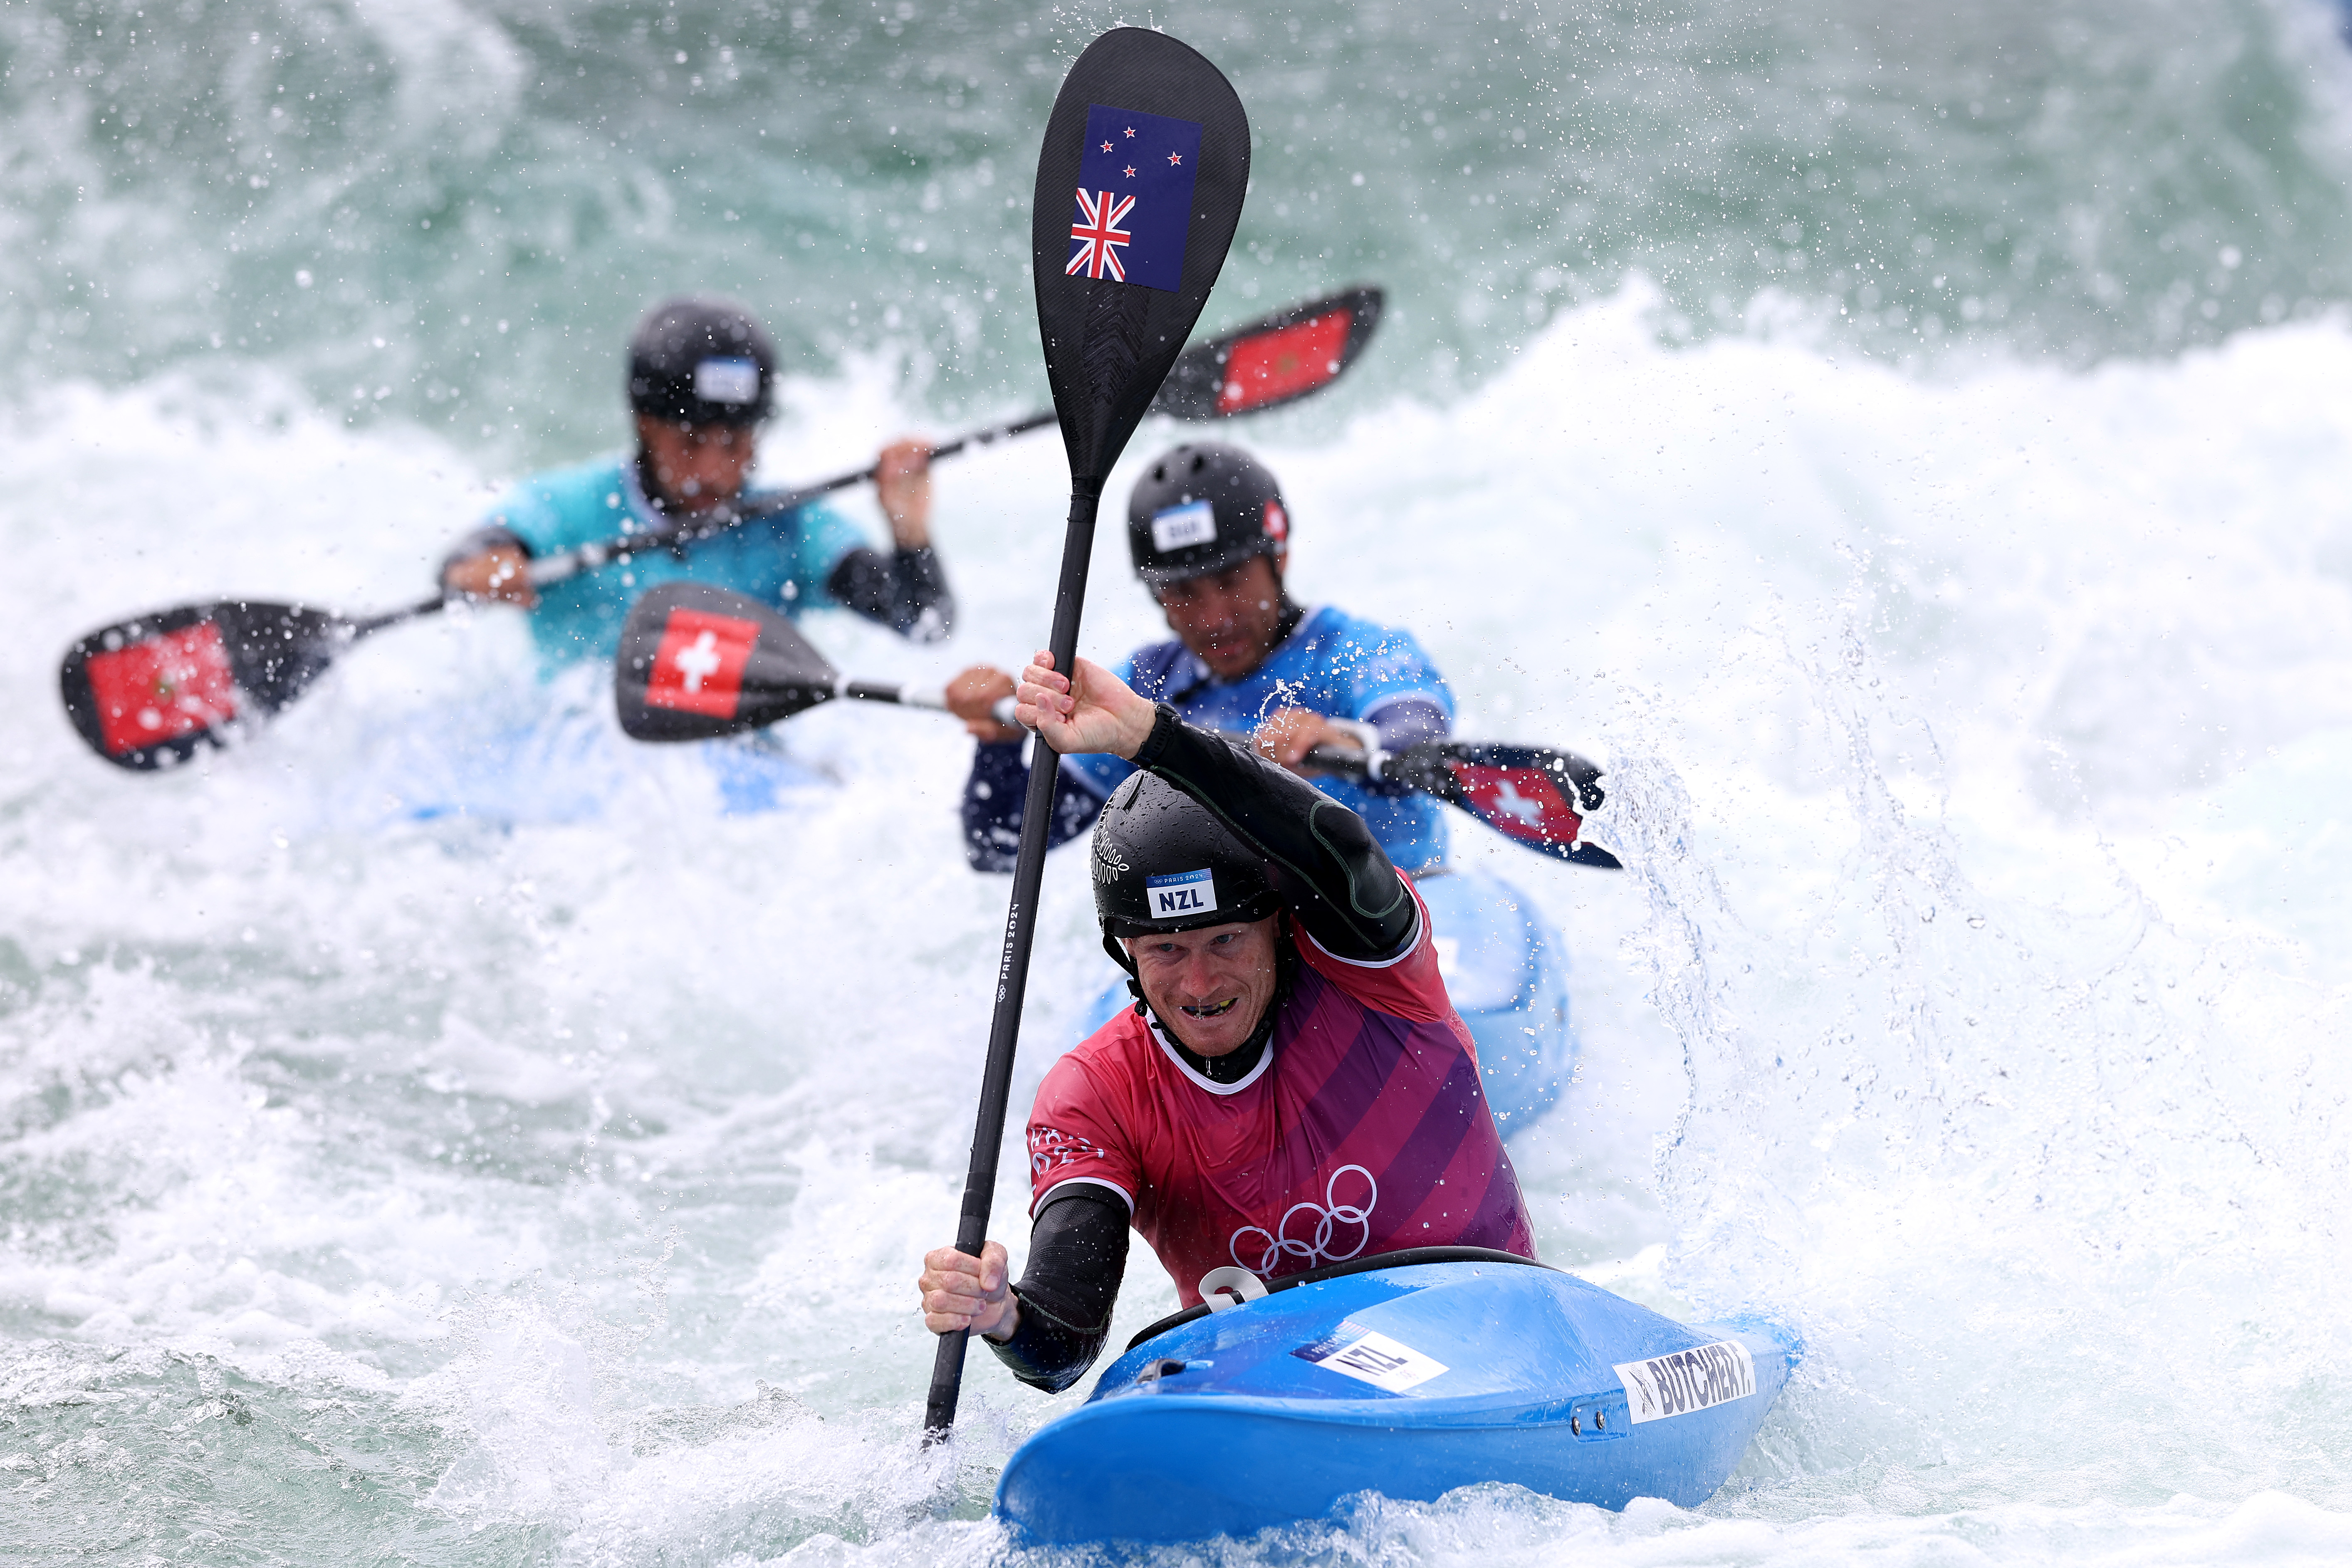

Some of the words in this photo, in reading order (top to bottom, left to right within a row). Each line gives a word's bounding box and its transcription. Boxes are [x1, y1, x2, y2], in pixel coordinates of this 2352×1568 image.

[1159, 889, 1204, 912] NZL
[1007, 904, 1019, 938] 2024
[1001, 942, 1014, 980] PARIS
[1336, 1345, 1408, 1376] NZL
[1646, 1344, 1739, 1415] BUTCHER
